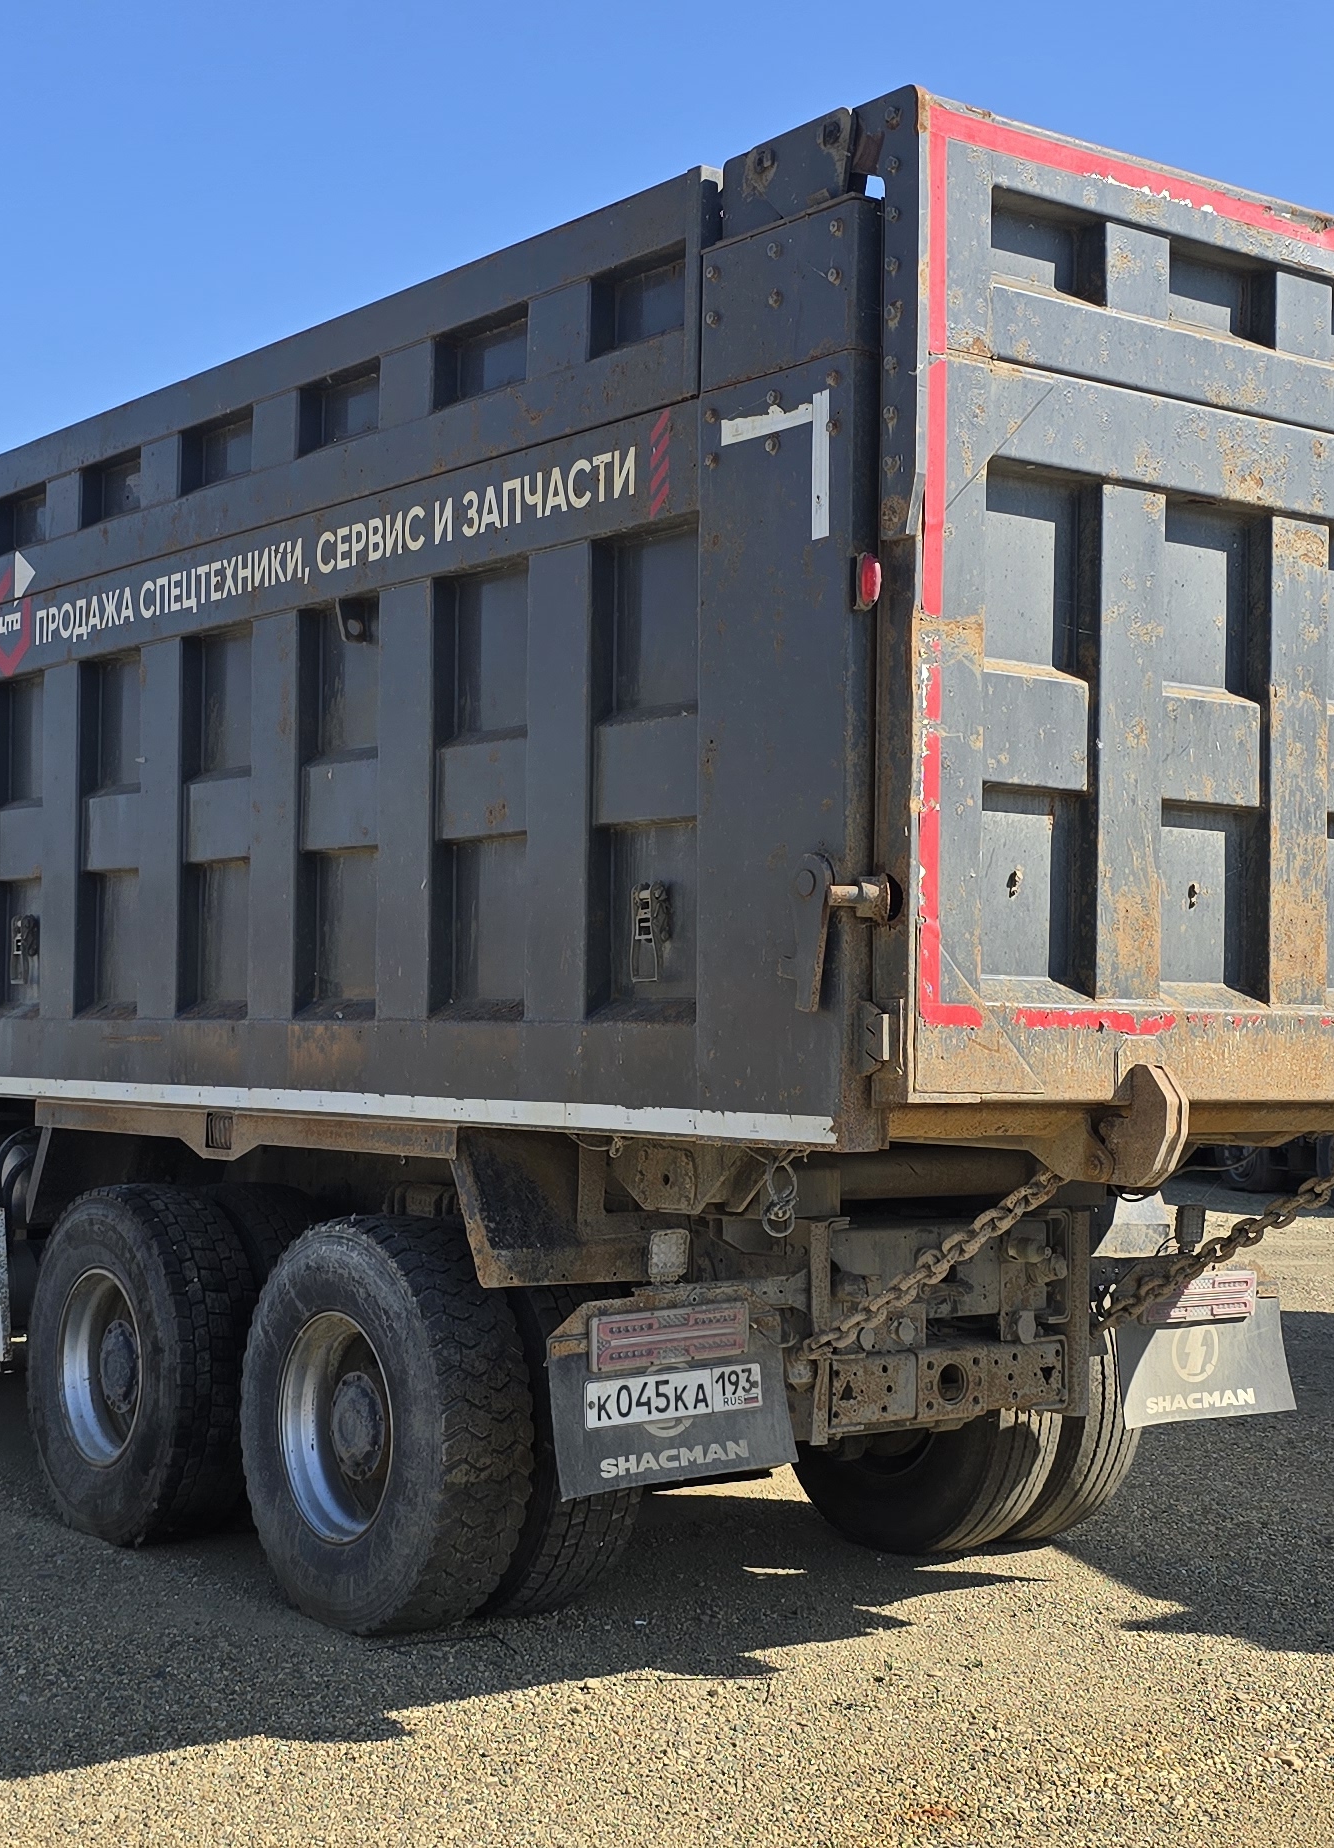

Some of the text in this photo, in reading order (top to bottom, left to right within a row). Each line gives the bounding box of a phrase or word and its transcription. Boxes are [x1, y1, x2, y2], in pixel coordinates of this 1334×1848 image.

[35, 446, 636, 645] ПРОДАЖА СПЕЦТЕХНИКИ, СЕРВИС И ЗАПЧАСТИ
[715, 1367, 754, 1397] 193
[723, 1396, 744, 1407] RUS
[1146, 1387, 1256, 1415] SHACMAN
[600, 1439, 750, 1480] SHACMAN
